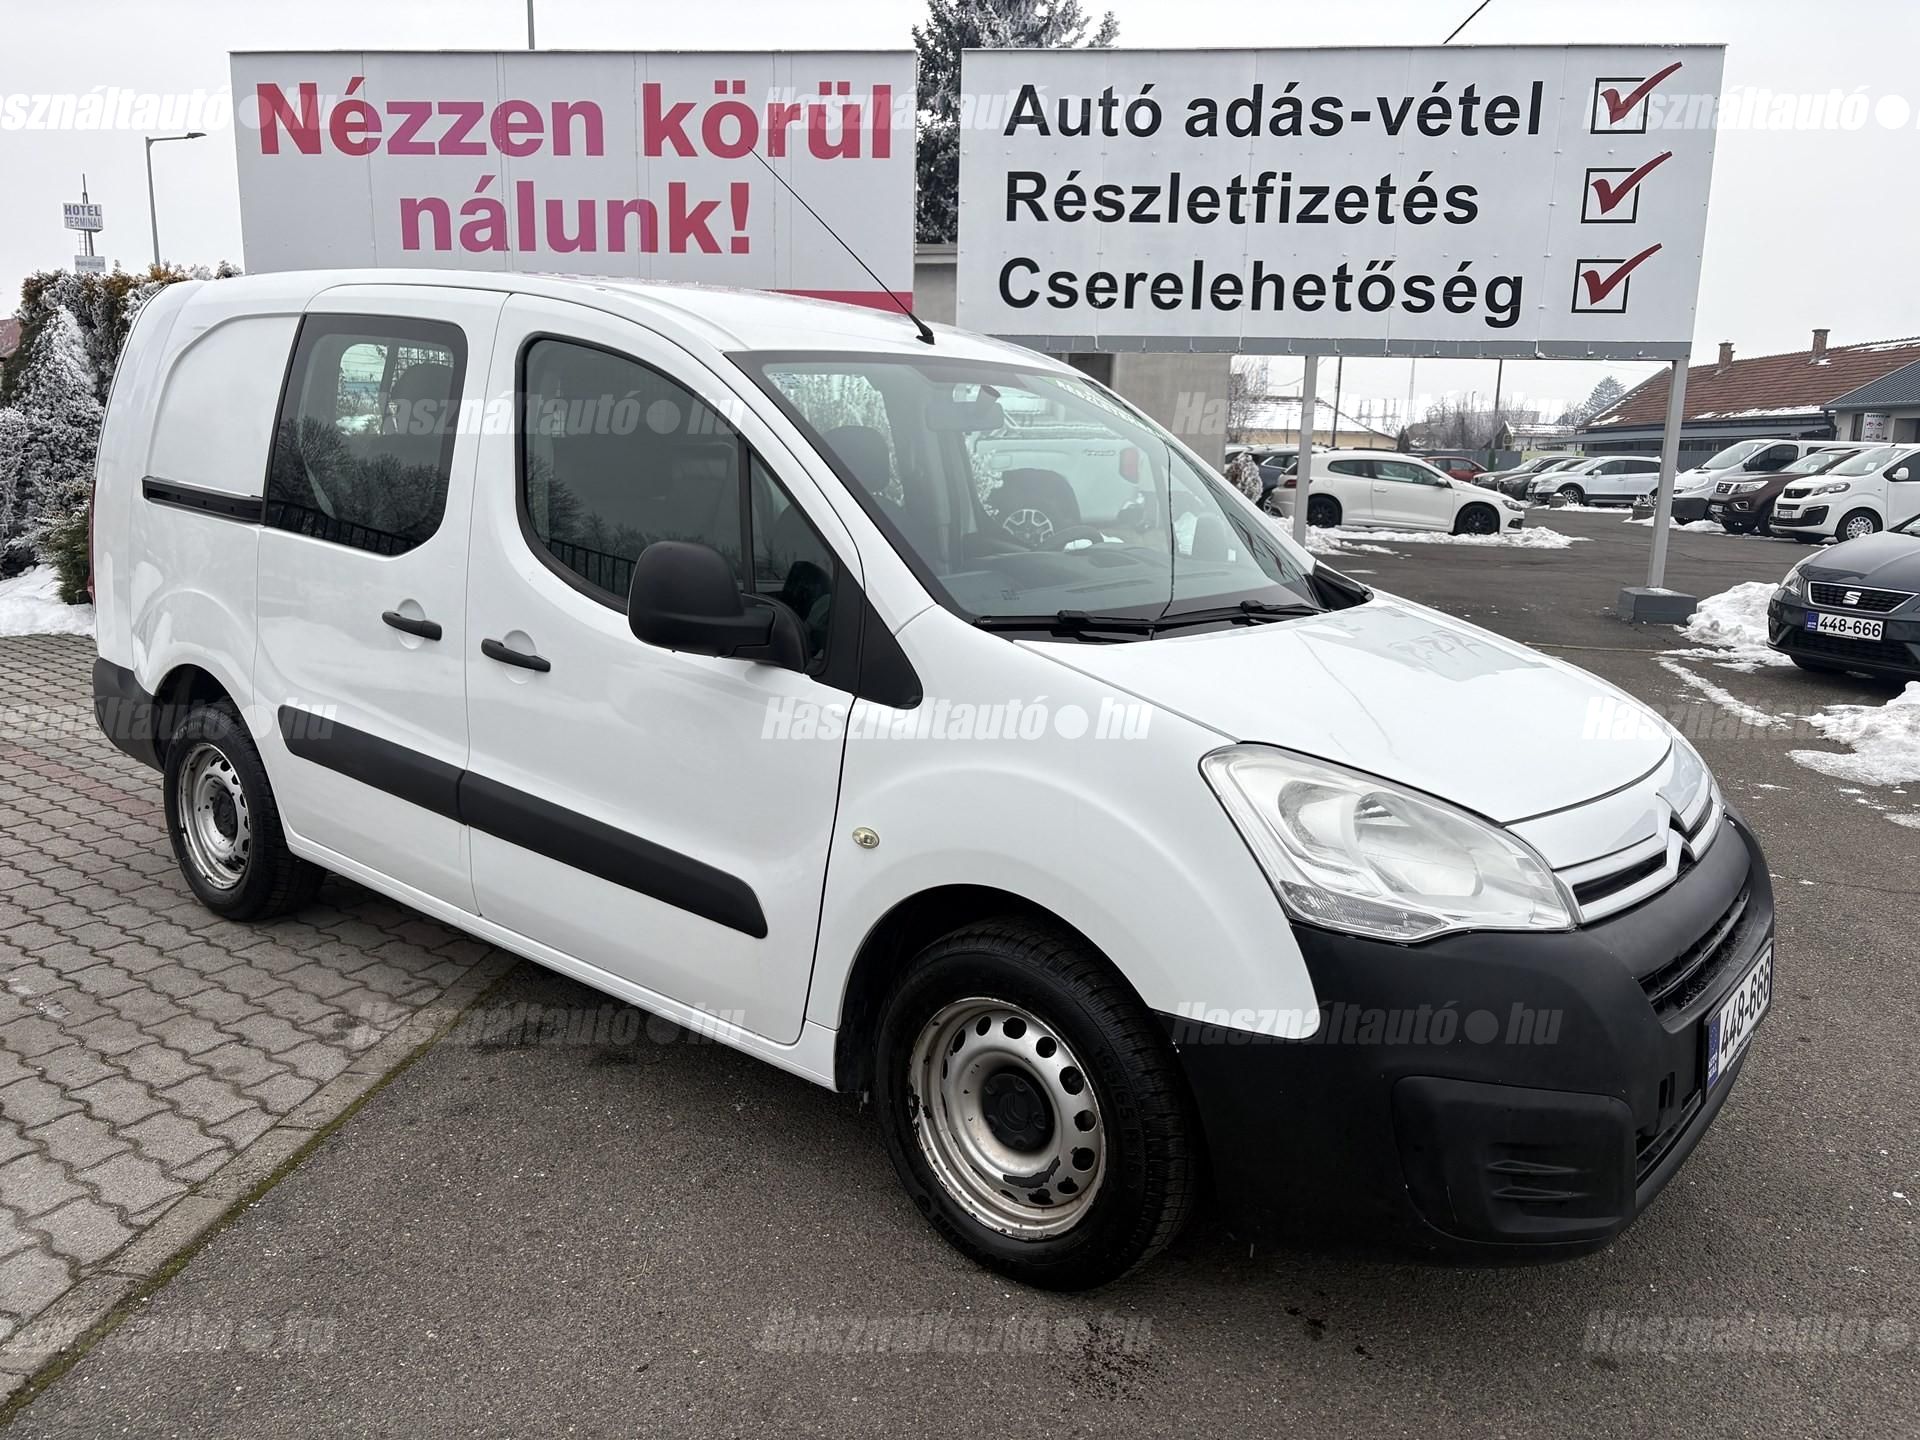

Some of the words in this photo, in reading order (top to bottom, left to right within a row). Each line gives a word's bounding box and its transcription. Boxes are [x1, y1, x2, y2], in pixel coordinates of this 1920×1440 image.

[257, 77, 604, 157] Nézzen
[643, 79, 892, 160] körül
[1003, 83, 1162, 138] Autó
[1184, 81, 1544, 138] adás-vétel
[64, 204, 101, 217] HOTEL
[65, 216, 103, 228] TERMINAL
[400, 175, 750, 254] nálunk!
[1006, 170, 1480, 225] Részletfizetés
[999, 257, 1524, 328] Cserelehetőség
[1820, 616, 1881, 638] 448-666
[1720, 955, 1771, 1059] 448-666
